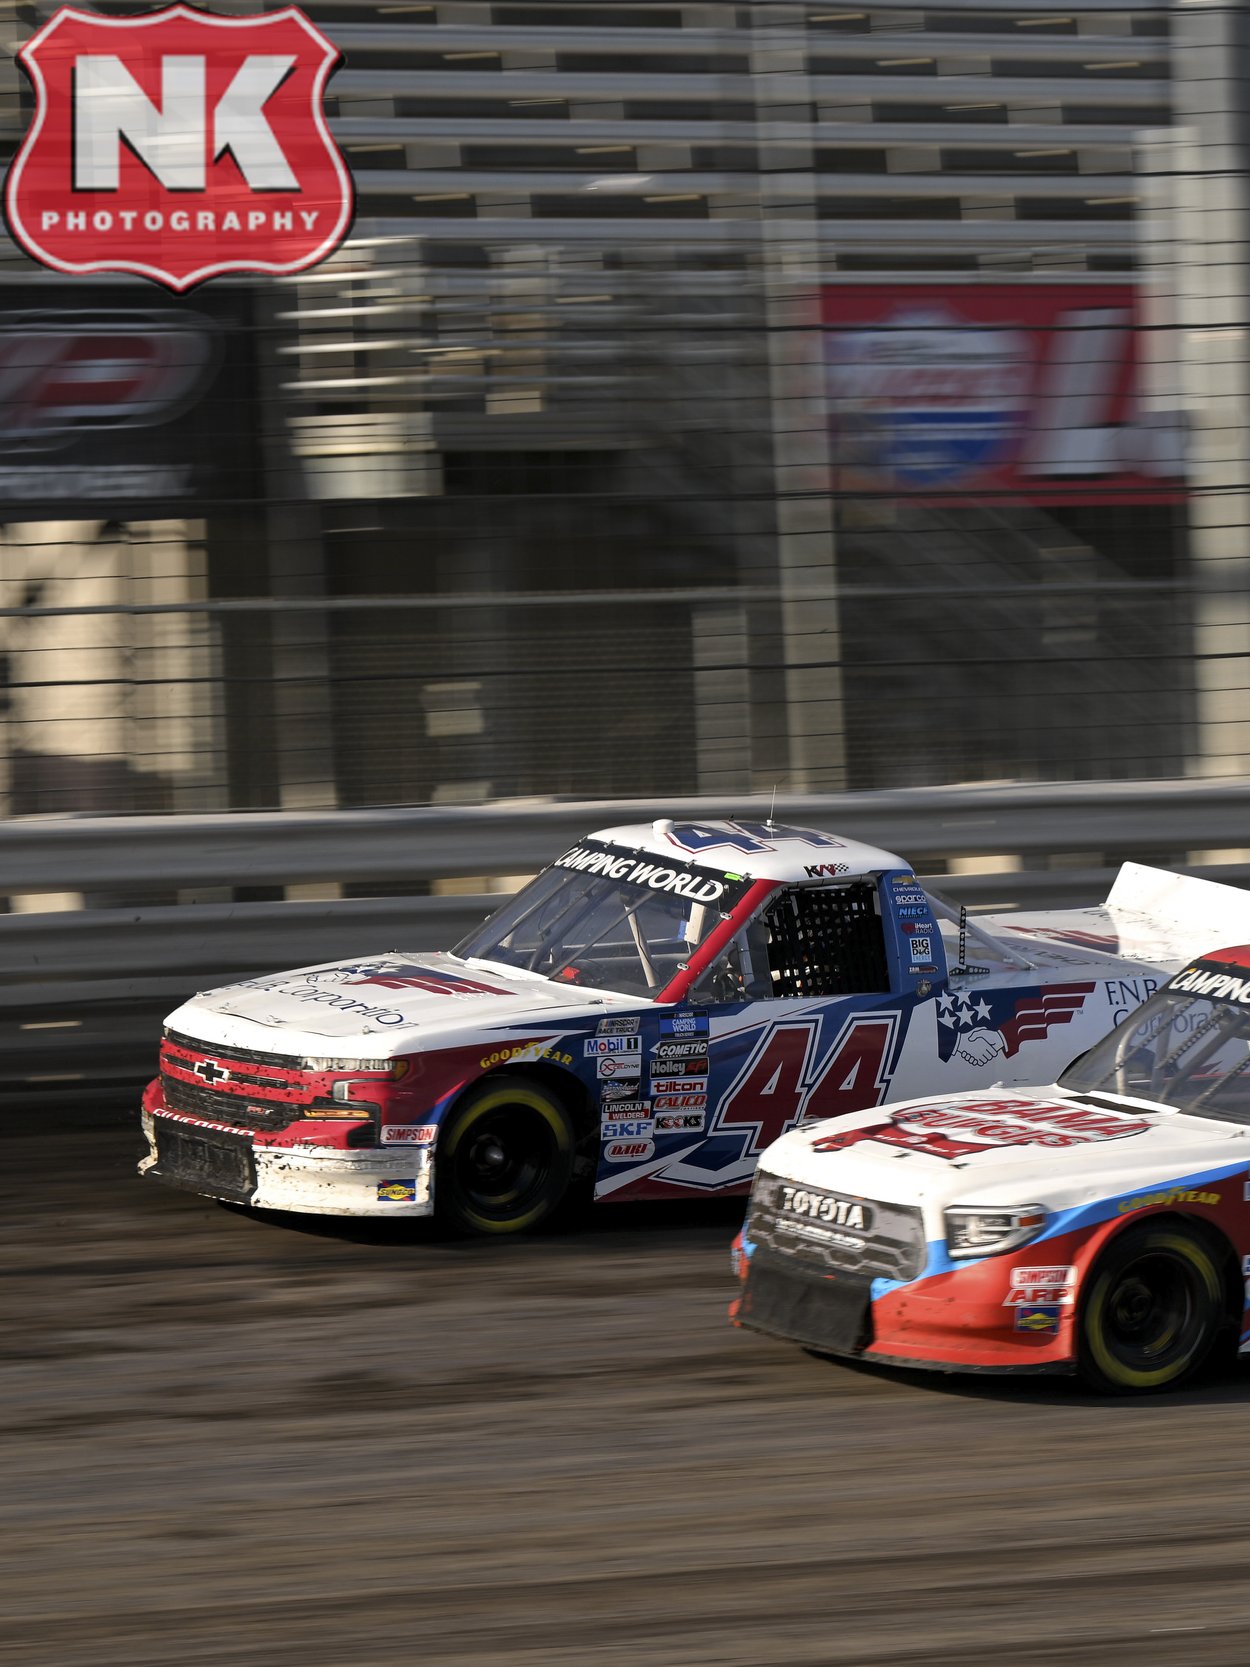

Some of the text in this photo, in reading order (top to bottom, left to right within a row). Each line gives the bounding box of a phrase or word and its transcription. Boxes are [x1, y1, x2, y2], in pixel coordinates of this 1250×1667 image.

[553, 847, 724, 901] CAMPING WORLD
[899, 907, 928, 916] NIECE
[911, 939, 929, 948] BIG
[279, 985, 418, 1030] Corporation
[672, 1024, 697, 1032] WORLD
[586, 1038, 623, 1053] Mobil
[659, 1043, 708, 1056] COMETIC
[479, 1041, 573, 1069] GOODYEAR
[651, 1061, 686, 1076] Holley
[654, 1081, 704, 1093] tilton
[712, 1012, 900, 1157] 44
[604, 1103, 643, 1113] LINCOLN
[655, 1095, 706, 1109] CALICO
[612, 1111, 646, 1120] WELDERS
[655, 1115, 703, 1129] KOOKS
[386, 1128, 433, 1142] SIMPSON
[602, 1122, 652, 1138] SKF
[378, 1188, 415, 1197] SUNOCO
[1117, 1186, 1222, 1214] GOODYEAR
[782, 1187, 864, 1229] TOYOTA
